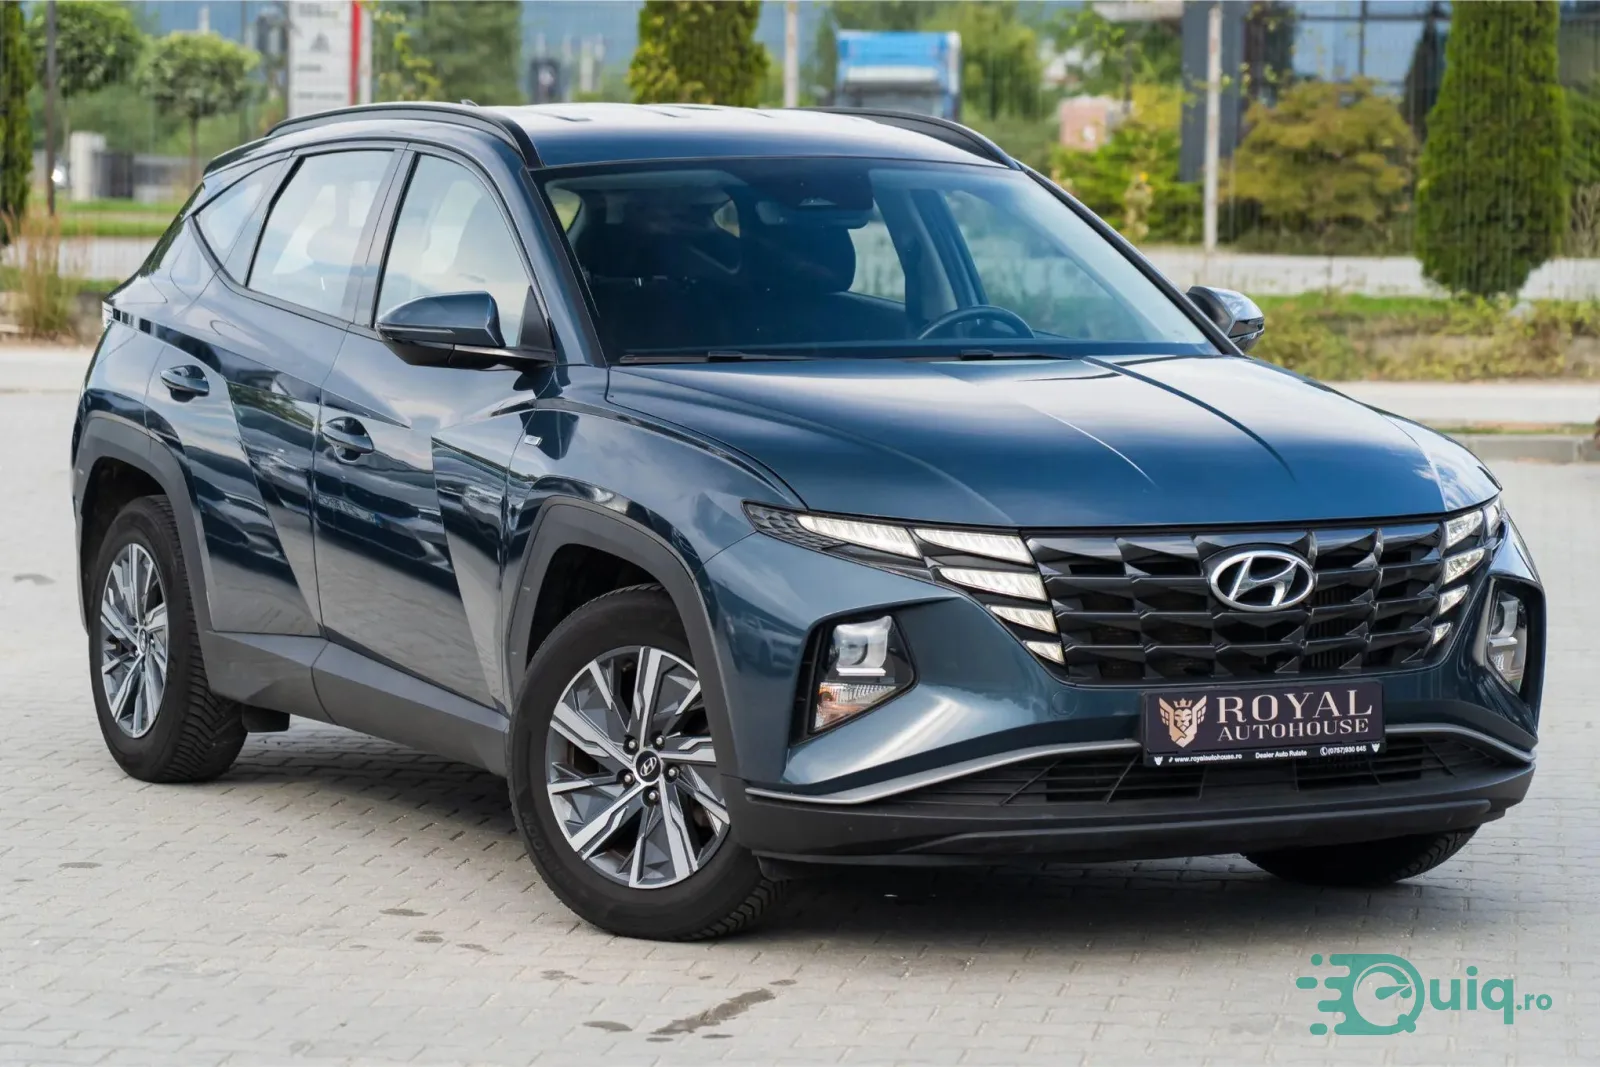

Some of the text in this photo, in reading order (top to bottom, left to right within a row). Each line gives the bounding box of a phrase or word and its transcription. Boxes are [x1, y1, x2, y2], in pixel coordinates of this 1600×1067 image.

[1216, 689, 1373, 724] ROYAL
[1217, 718, 1369, 742] AUTOHOUSE
[1174, 753, 1243, 763] www.royalautohouse.ro
[1289, 749, 1308, 757] Rulate
